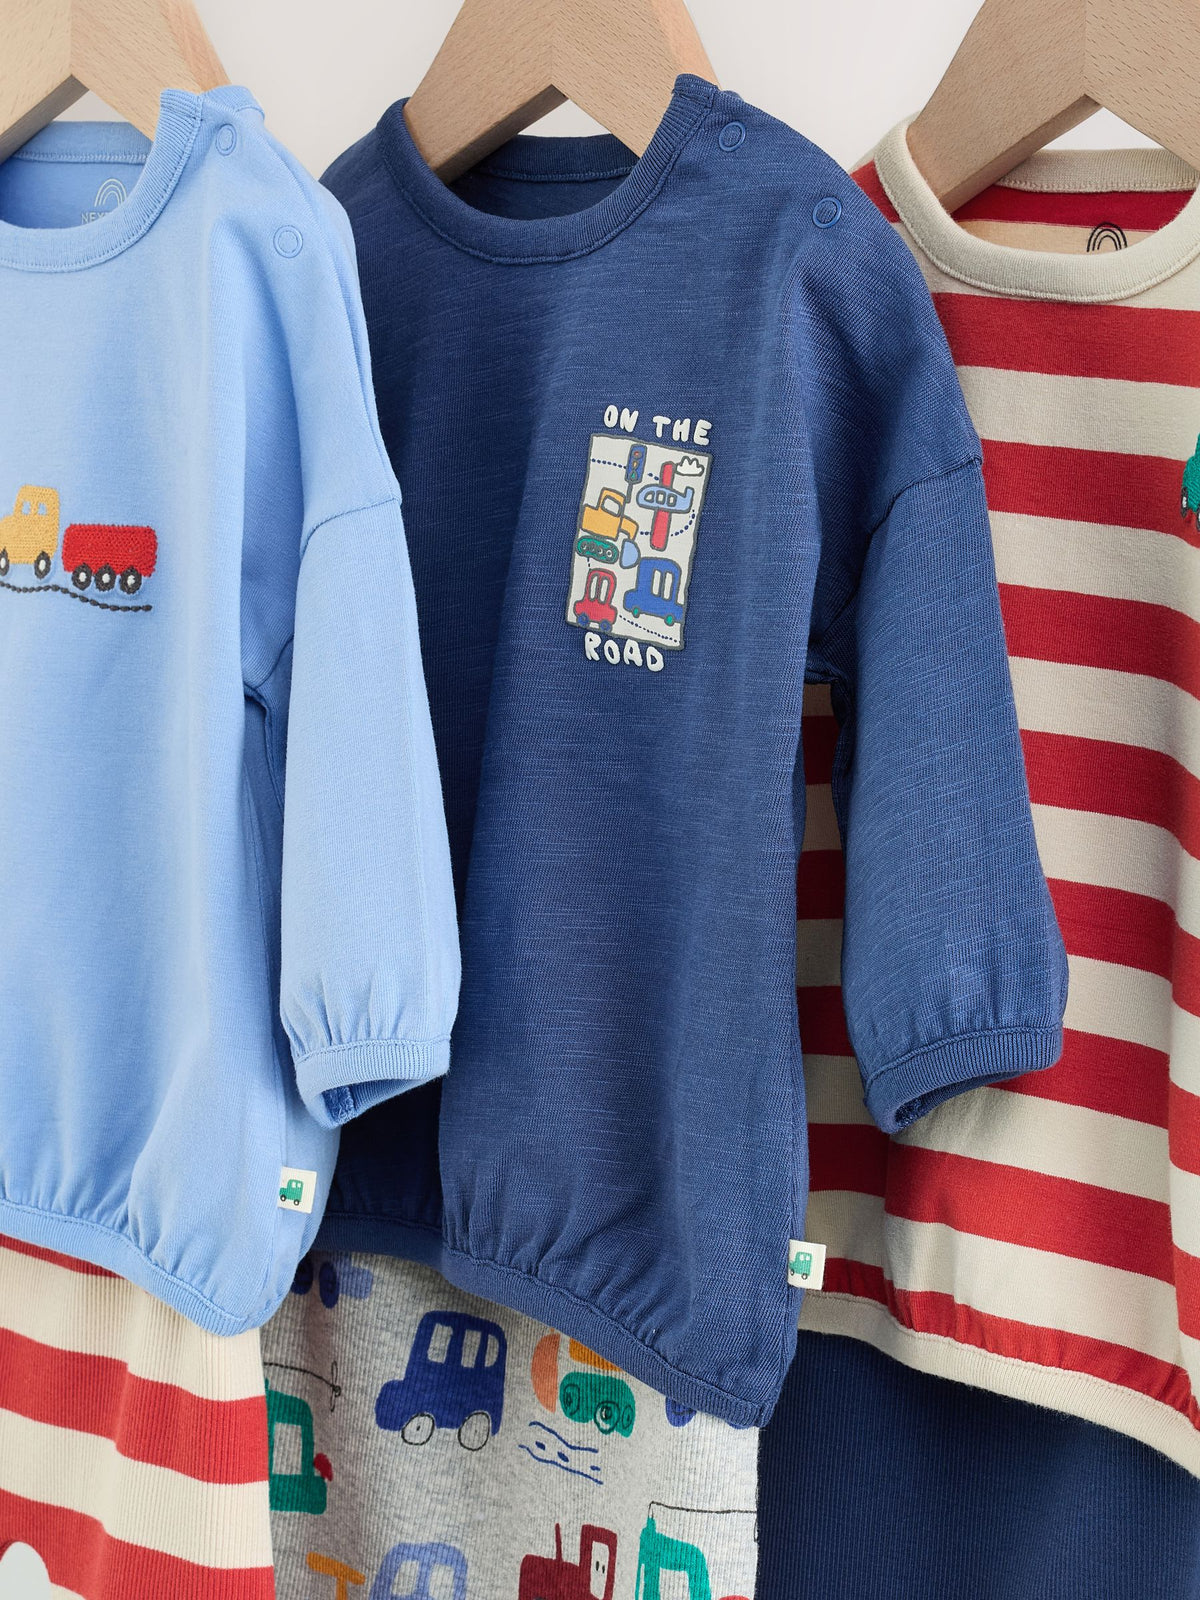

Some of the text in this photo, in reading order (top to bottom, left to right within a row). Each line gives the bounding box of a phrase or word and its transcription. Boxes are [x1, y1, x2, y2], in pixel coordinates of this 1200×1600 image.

[603, 404, 712, 446] ON THE
[584, 631, 664, 672] ROAD
